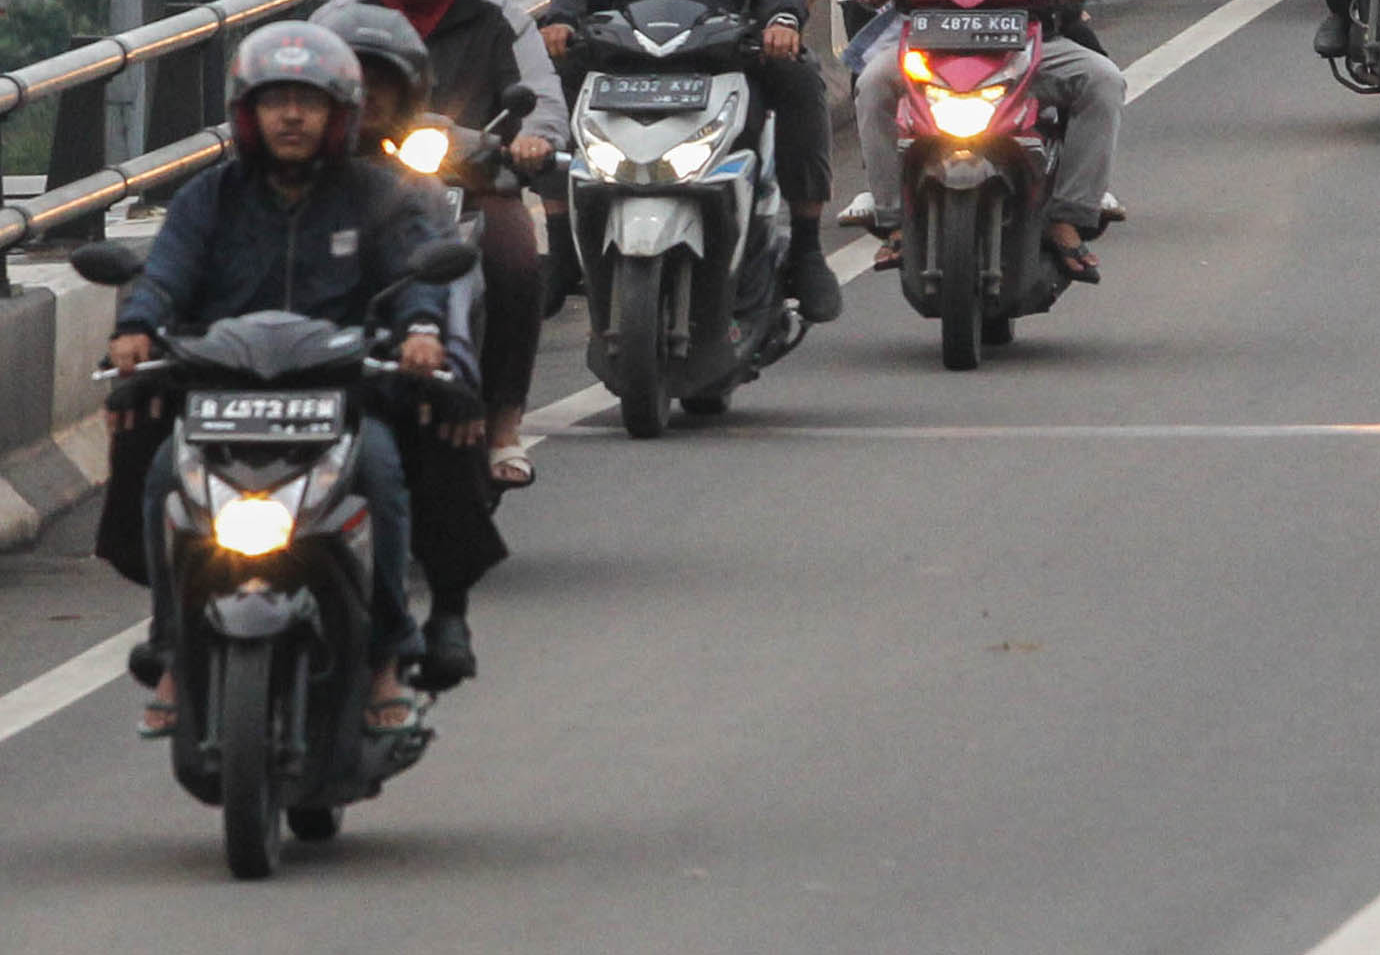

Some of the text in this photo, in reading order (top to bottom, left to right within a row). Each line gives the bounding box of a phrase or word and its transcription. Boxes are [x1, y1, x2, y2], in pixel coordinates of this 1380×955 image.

[917, 17, 1020, 30] B 4876 KGL
[600, 80, 610, 92] B
